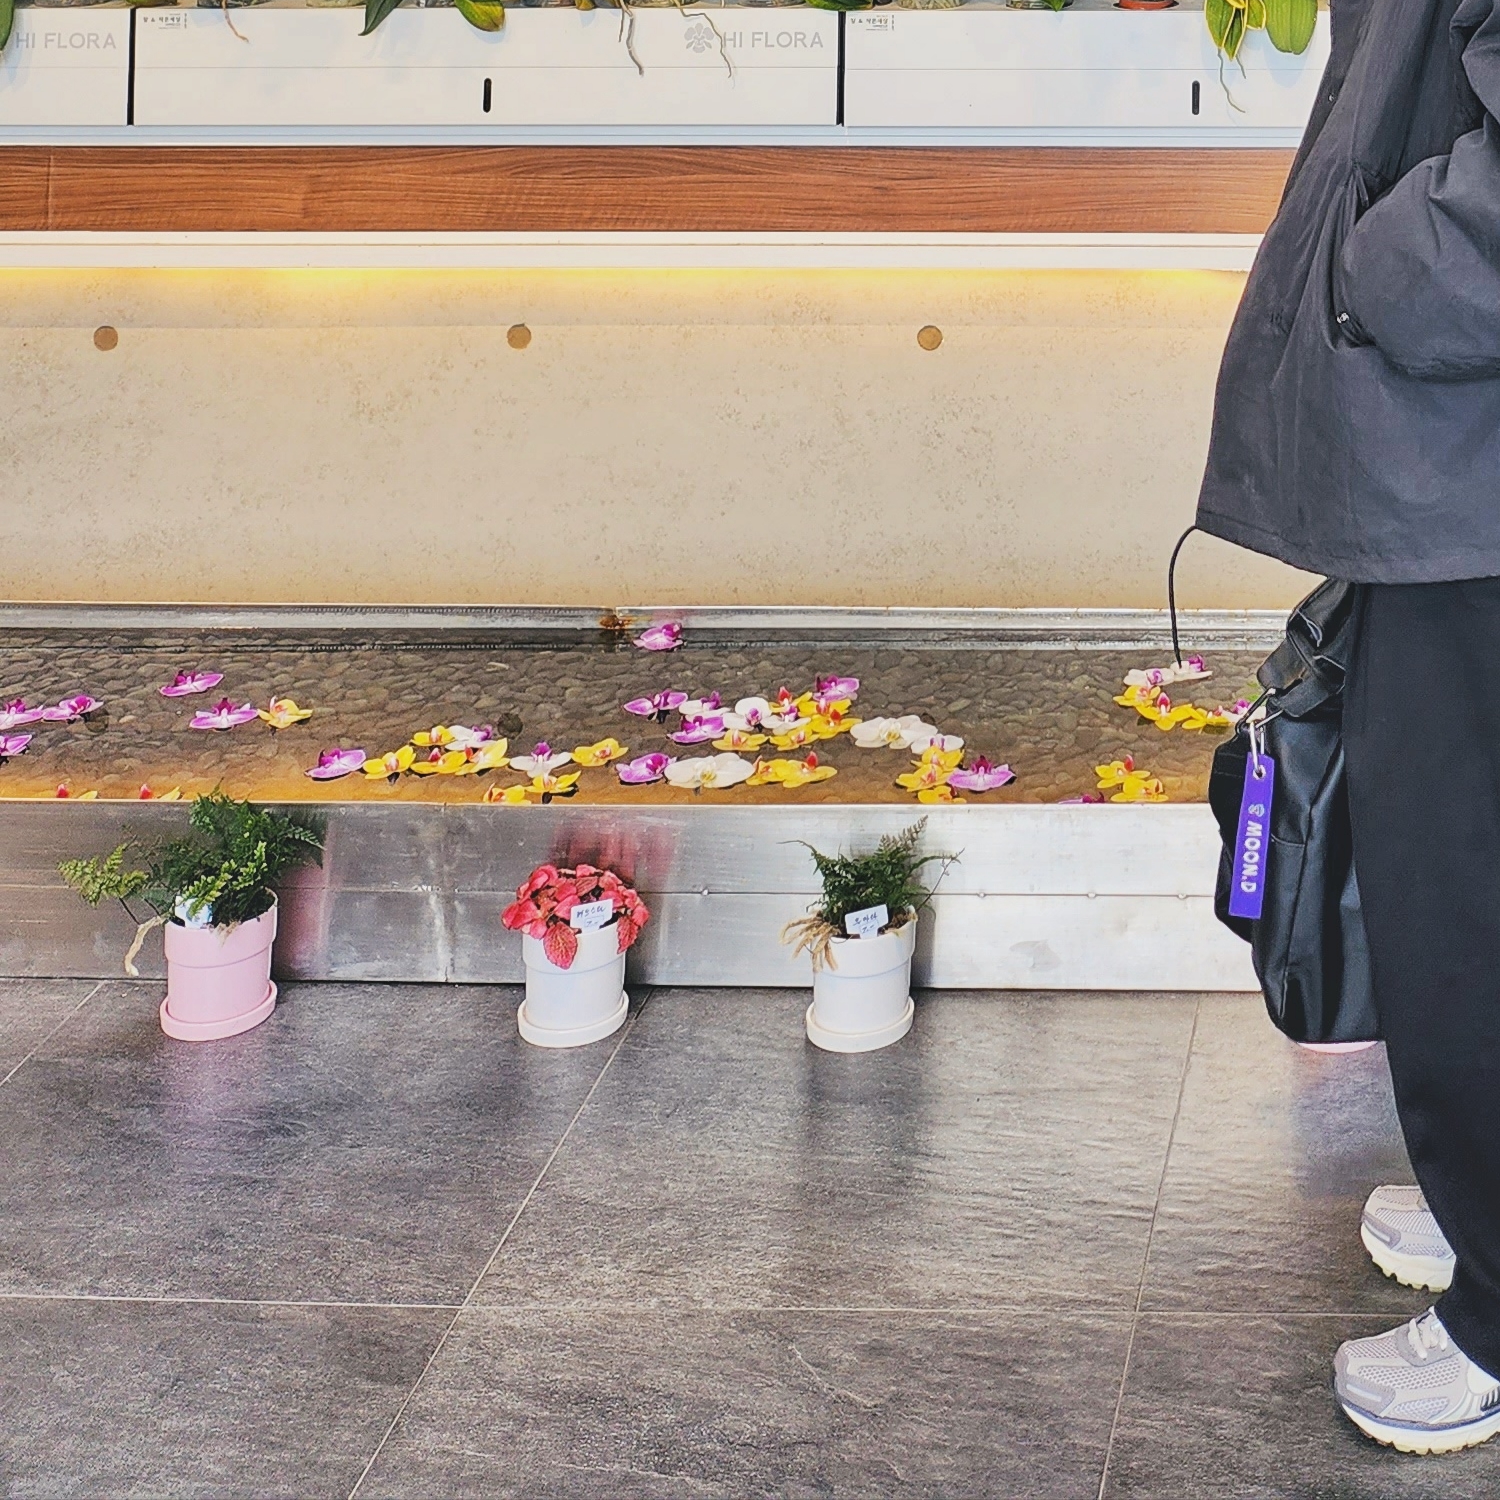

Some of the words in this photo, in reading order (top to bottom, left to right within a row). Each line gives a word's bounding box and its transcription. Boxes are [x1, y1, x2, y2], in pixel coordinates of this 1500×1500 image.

[16, 33, 35, 49] HI
[44, 32, 116, 49] FLORA
[724, 32, 743, 49] HI
[752, 31, 824, 49] FLORA
